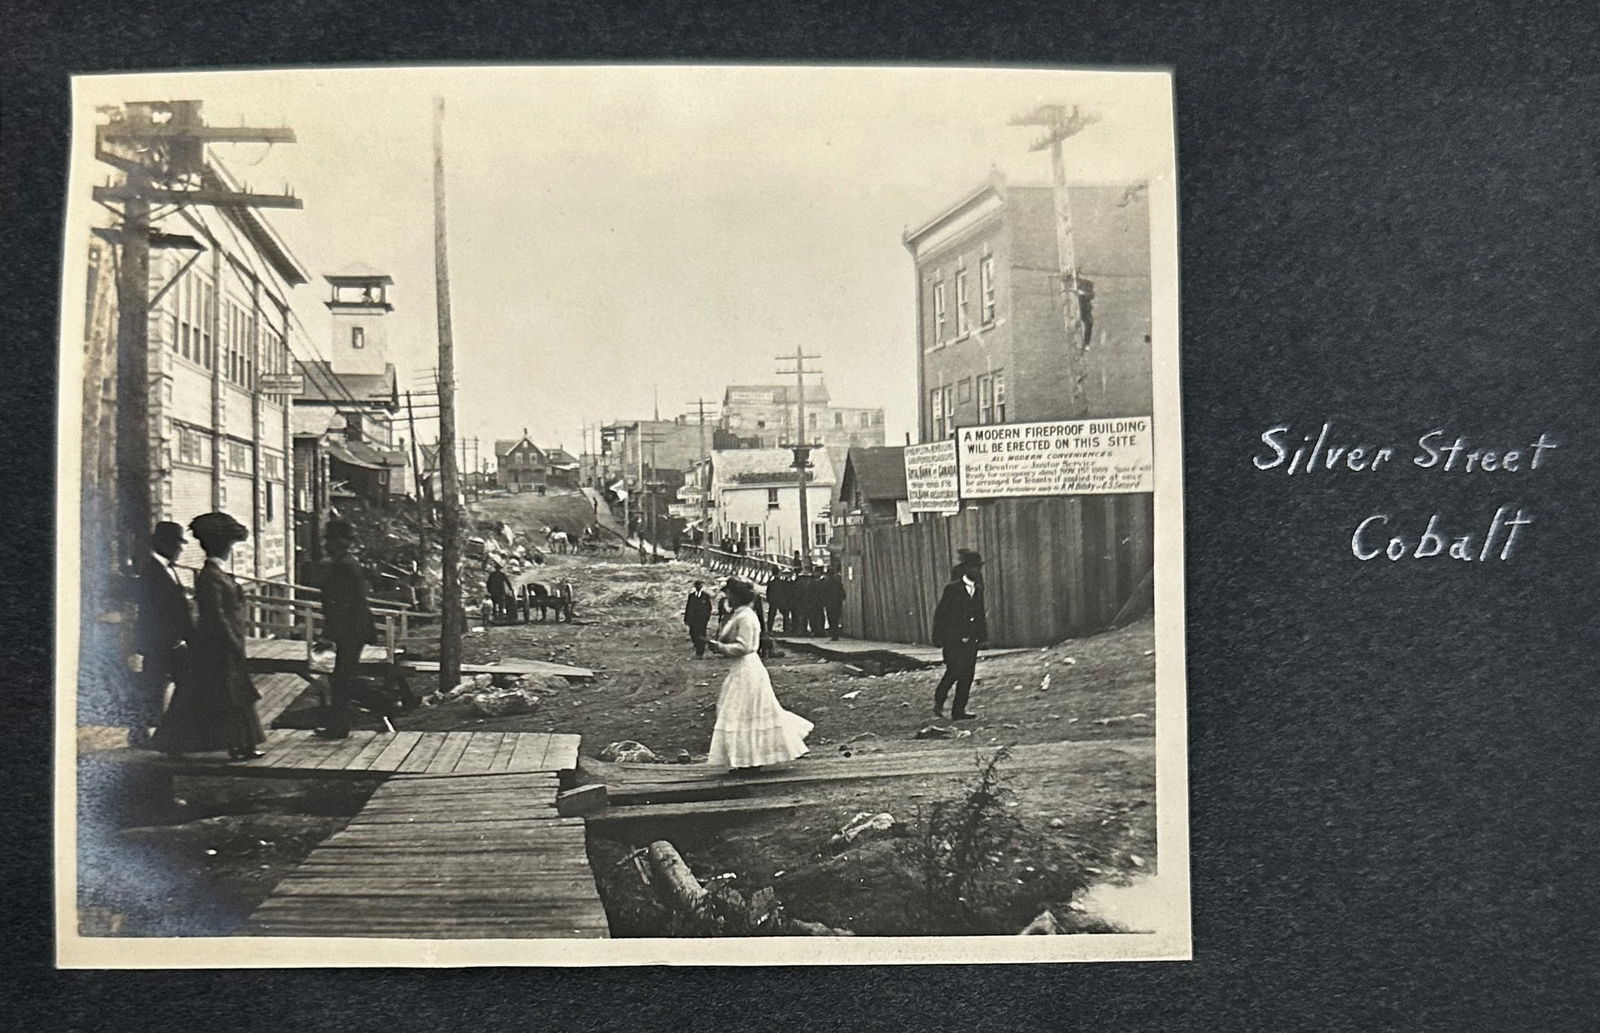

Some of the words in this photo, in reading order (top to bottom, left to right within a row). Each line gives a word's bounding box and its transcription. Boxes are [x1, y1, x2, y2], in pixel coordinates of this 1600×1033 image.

[964, 431, 972, 442] A
[975, 428, 1020, 441] MODERN
[1025, 424, 1084, 438] FIREPROOF
[1090, 421, 1146, 434] BUILDING
[967, 444, 988, 454] WILL
[992, 442, 1003, 452] BE
[1006, 440, 1050, 452] ERECTED
[1055, 438, 1069, 449] ON
[1073, 437, 1100, 448] THIS
[1108, 436, 1136, 447] SITE
[1253, 423, 1392, 475] Silver
[1413, 429, 1557, 473] Street
[1351, 507, 1532, 562] Cobalt
